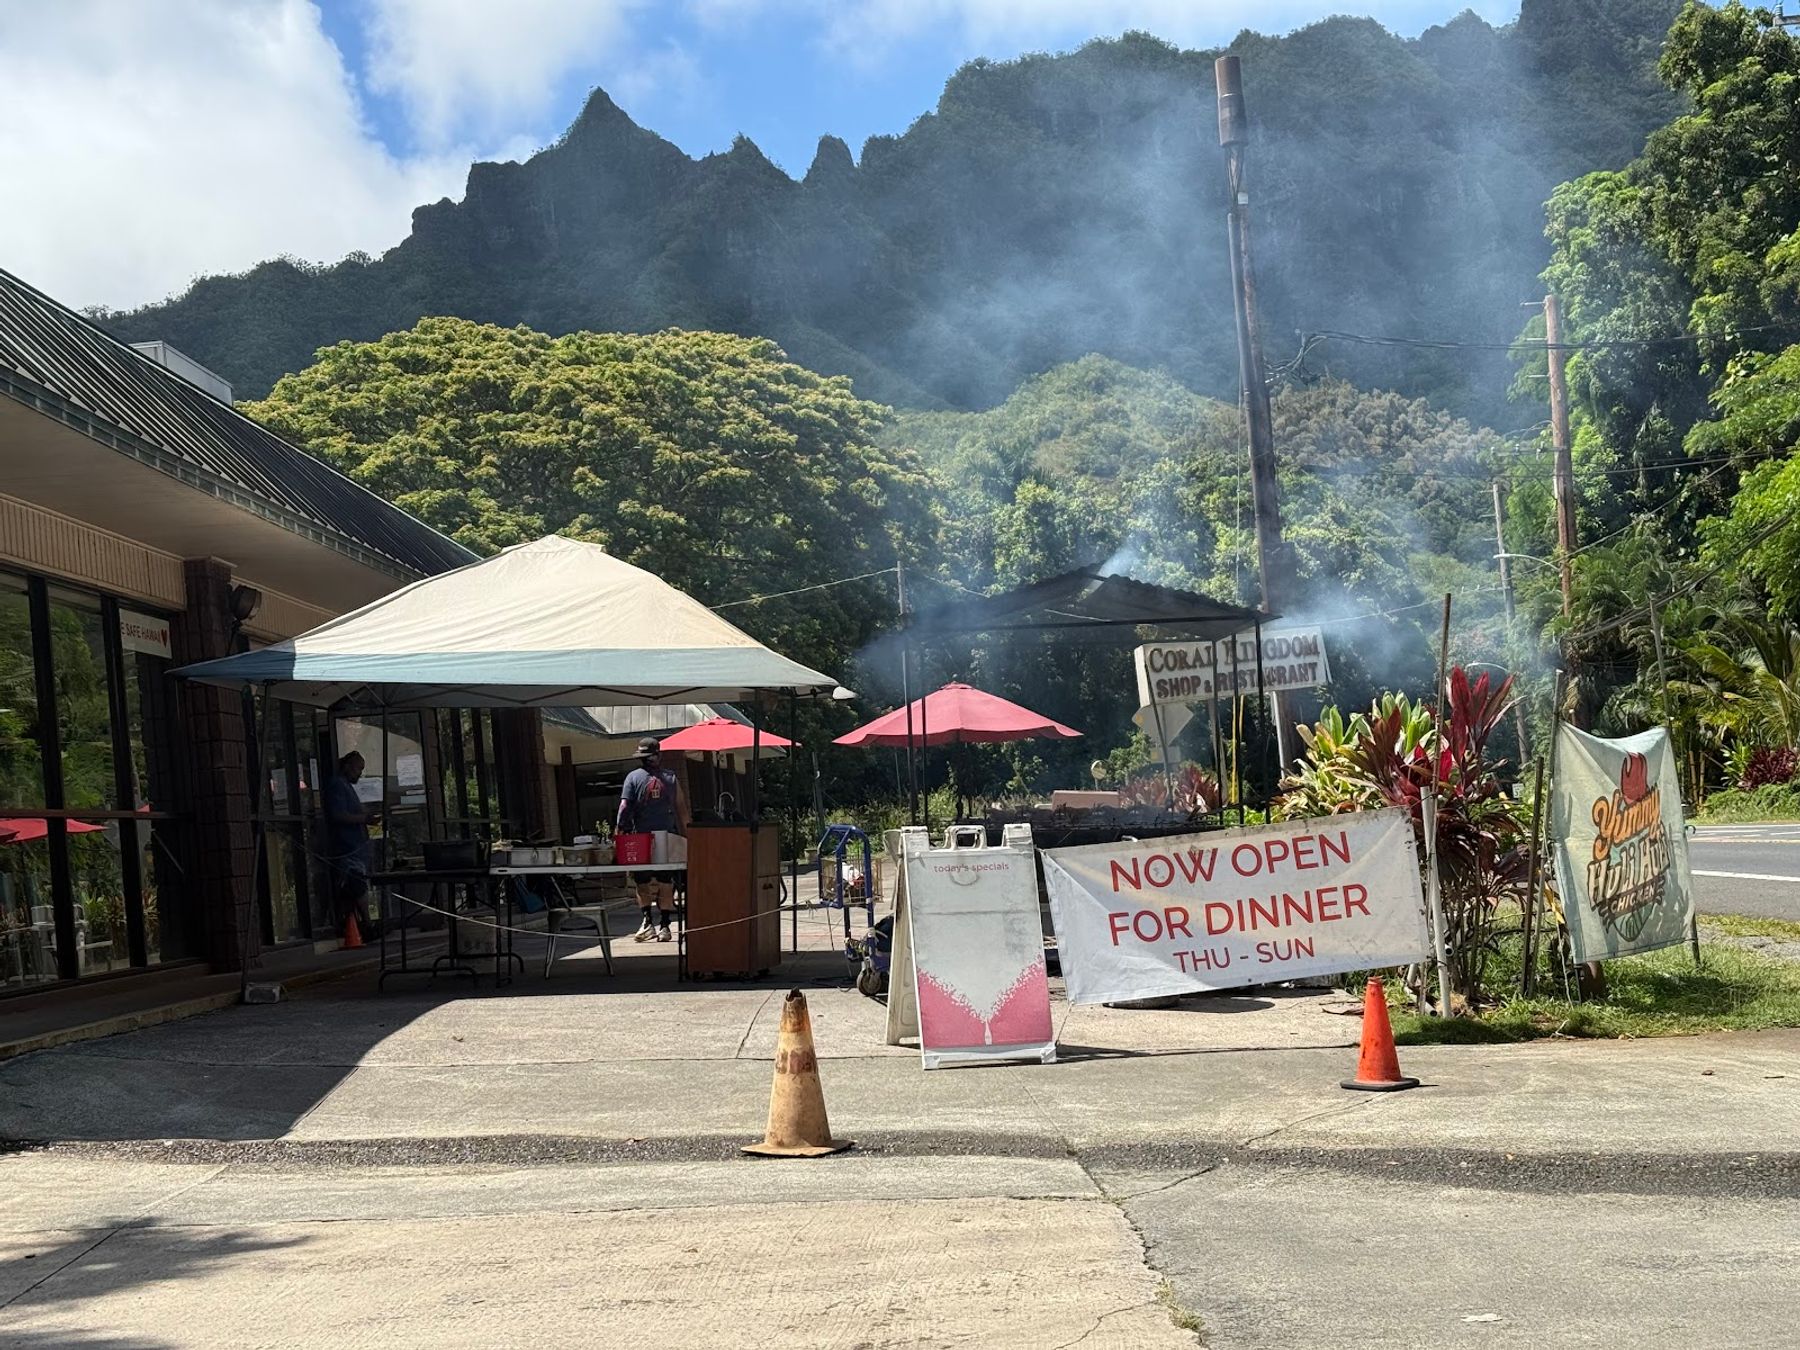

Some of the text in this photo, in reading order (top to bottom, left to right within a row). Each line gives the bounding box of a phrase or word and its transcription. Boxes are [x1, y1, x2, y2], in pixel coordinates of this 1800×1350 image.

[126, 623, 141, 638] SAFE
[1157, 675, 1201, 698] SHOP
[1204, 680, 1212, 693] &
[1592, 786, 1664, 861] Yummy
[934, 861, 1009, 873] today's specials
[1110, 831, 1351, 892] NOW OPEN
[1611, 883, 1656, 913] CHICKEN
[1108, 884, 1372, 946] FOR DINNER
[1173, 947, 1230, 974] THU
[1256, 937, 1315, 964] SUN
